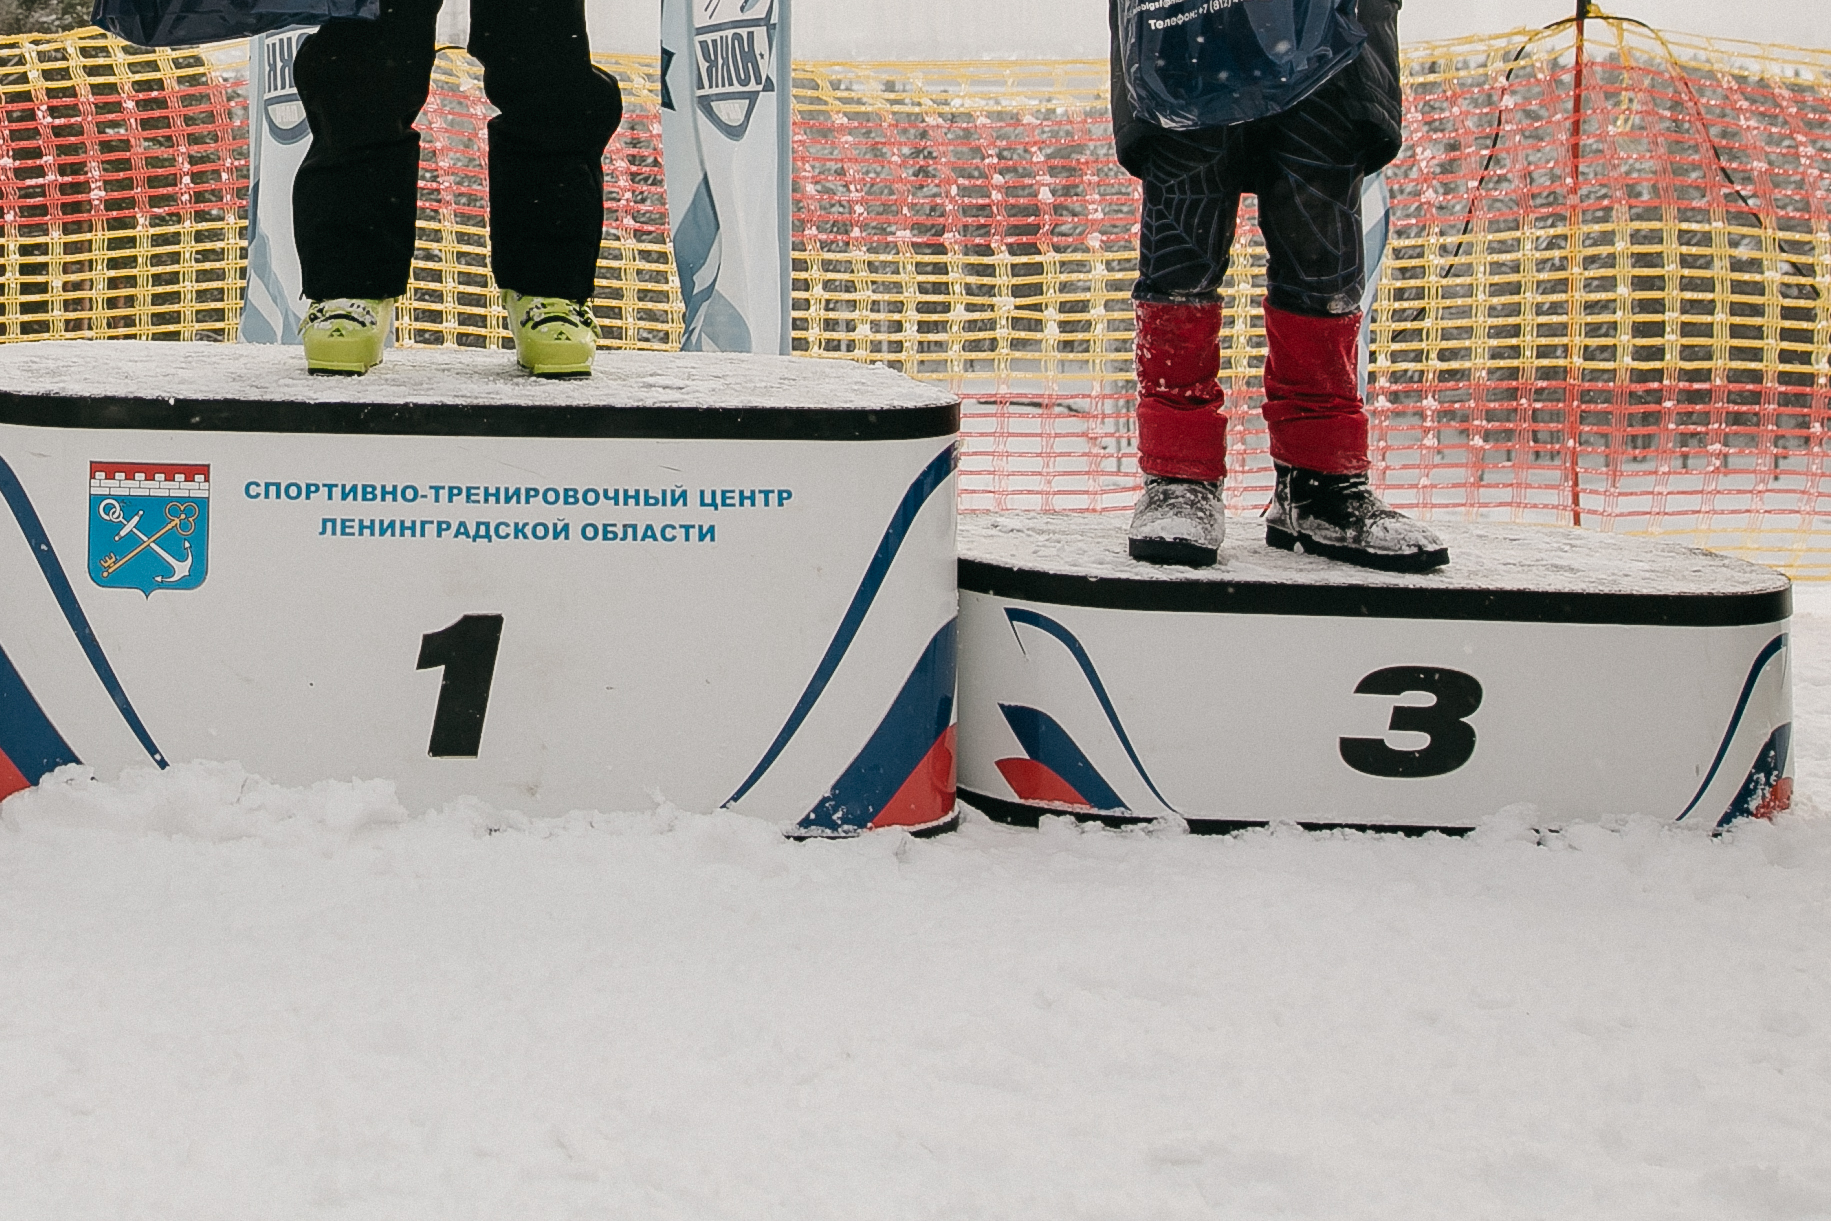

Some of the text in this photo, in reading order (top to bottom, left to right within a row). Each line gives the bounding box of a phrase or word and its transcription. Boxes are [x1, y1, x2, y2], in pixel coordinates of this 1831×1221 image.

[1148, 9, 1198, 30] Телефон:
[244, 478, 794, 511] СПОРТИВНО-ТРЕНИРОВОЧНЫЙ ЦЕНТР
[318, 515, 717, 545] ЛЕНИНГРАДСКОЙ ОБЛАСТИ
[415, 613, 505, 760] 1
[1338, 665, 1484, 778] 3
